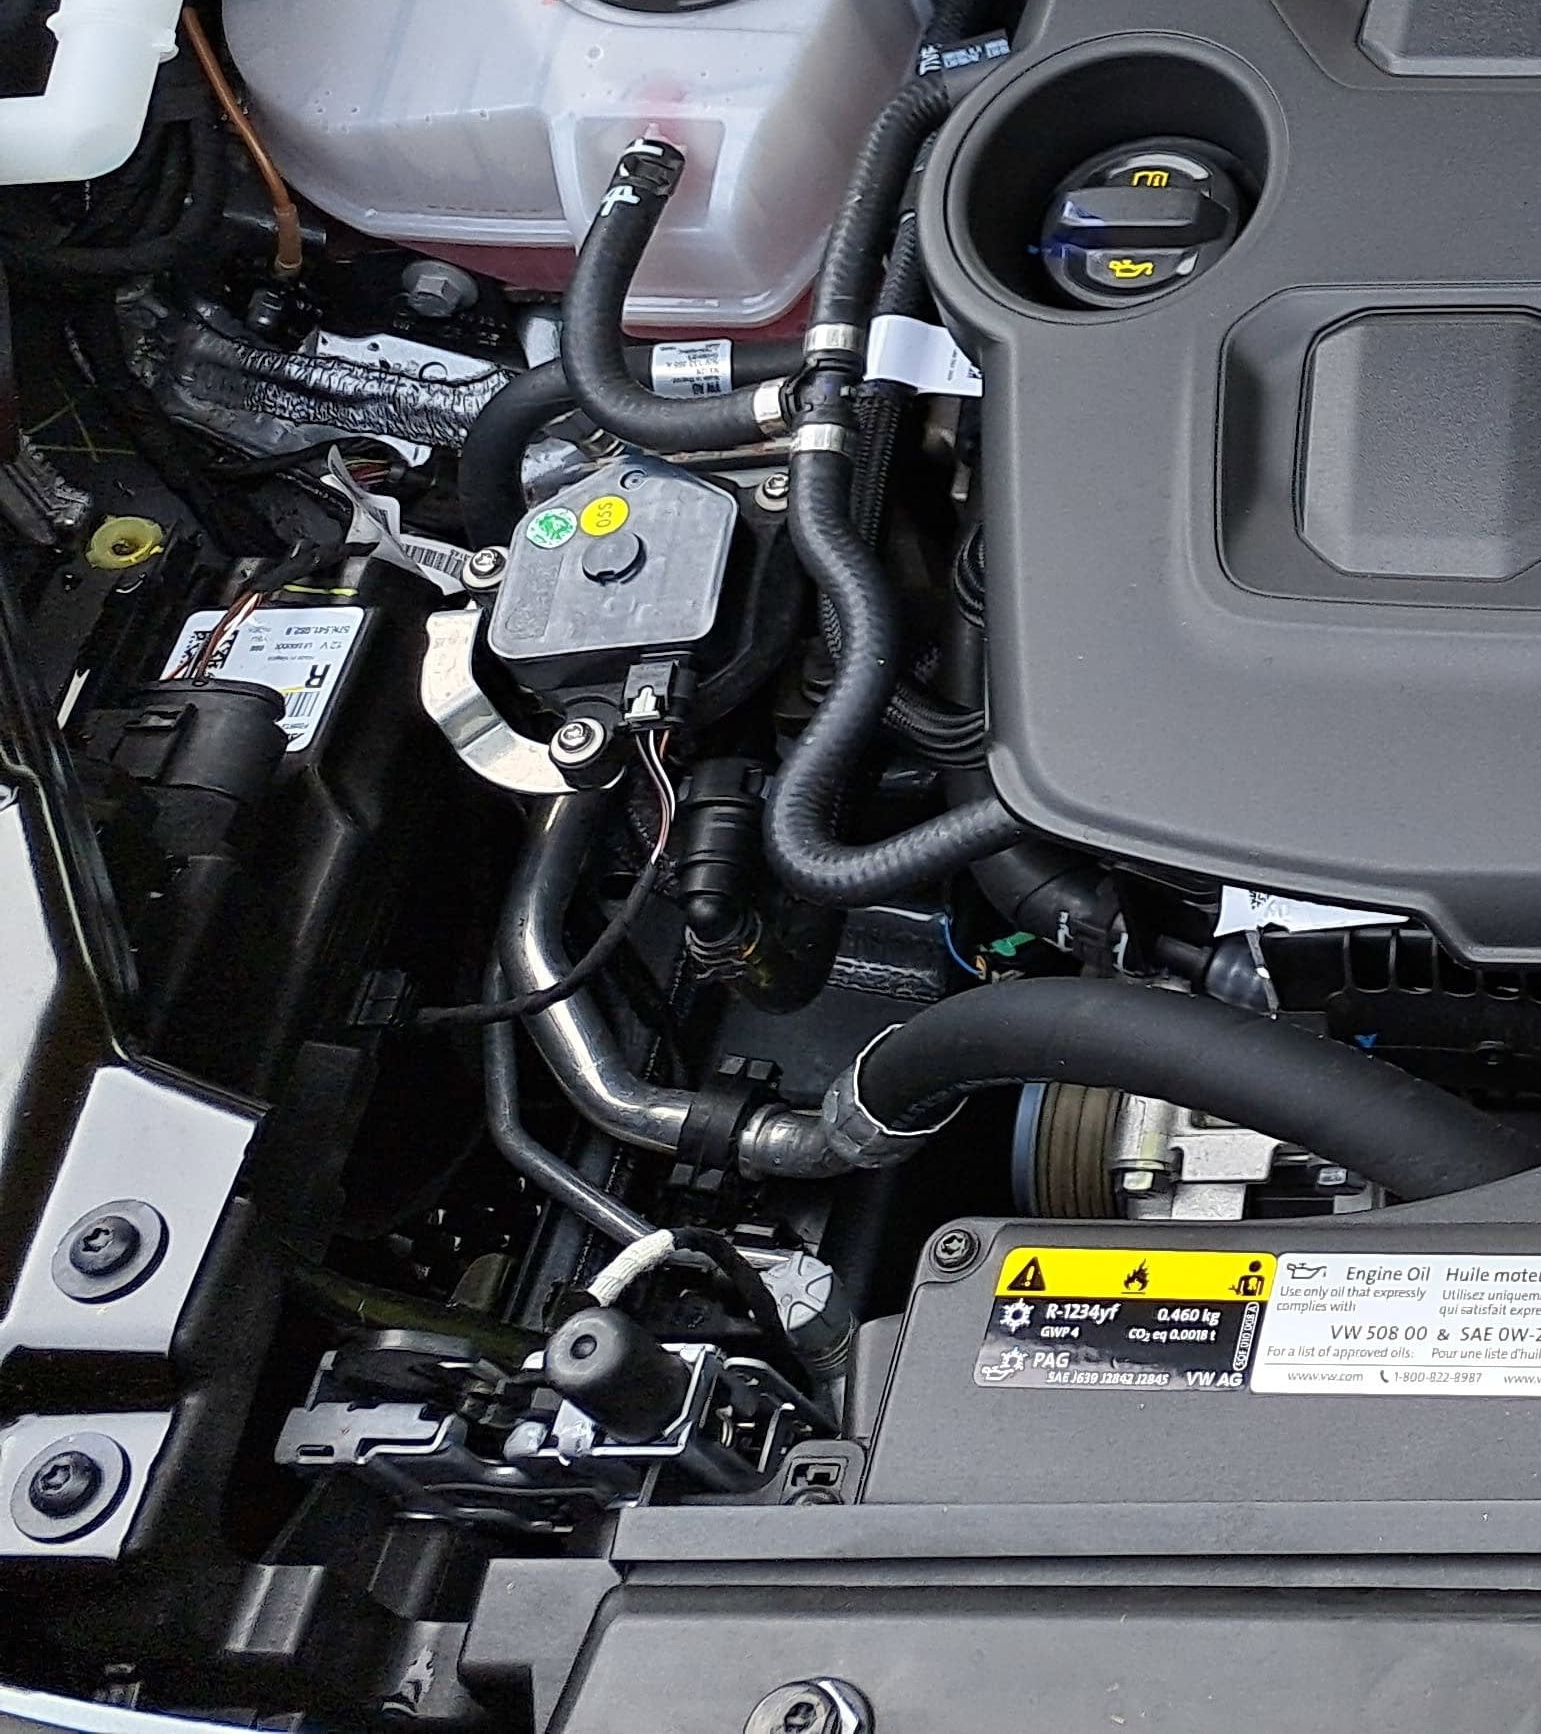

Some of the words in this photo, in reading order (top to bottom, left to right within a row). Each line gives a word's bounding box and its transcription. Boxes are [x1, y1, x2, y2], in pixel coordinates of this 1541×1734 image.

[304, 664, 331, 688] R
[1346, 1266, 1403, 1286] Engine
[1407, 1266, 1431, 1281] Oil
[1446, 1266, 1490, 1282] Huile
[1280, 1286, 1302, 1297] Use
[1303, 1286, 1329, 1300] only
[1330, 1286, 1345, 1297] oil
[1347, 1286, 1371, 1297] that
[1373, 1287, 1427, 1301] expressly
[1442, 1289, 1485, 1301] Utilisez
[1046, 1303, 1122, 1324] R-1234yf
[1156, 1307, 1200, 1322] 0.460
[1201, 1308, 1221, 1326] kg
[1276, 1301, 1327, 1314] complies
[1330, 1301, 1356, 1312] with
[1439, 1305, 1459, 1318] qui
[1460, 1304, 1507, 1316] satisfait
[1040, 1326, 1069, 1339] GWP
[1069, 1326, 1080, 1339] 4
[1152, 1331, 1168, 1343] eq
[1168, 1329, 1208, 1342] 0.0018
[1208, 1330, 1217, 1341] t
[1330, 1325, 1363, 1341] VW
[1366, 1325, 1400, 1341] 508
[1404, 1326, 1428, 1341] 00
[1437, 1328, 1450, 1341] &
[1460, 1326, 1494, 1342] SAE
[1033, 1351, 1070, 1369] PAG
[1267, 1346, 1285, 1358] For
[1287, 1349, 1295, 1357] a
[1298, 1346, 1315, 1357] list
[1318, 1346, 1330, 1357] of
[1333, 1347, 1388, 1360] approved
[1390, 1347, 1415, 1358] oils:
[1431, 1348, 1458, 1359] Pour
[1460, 1350, 1482, 1360] une
[1484, 1348, 1508, 1360] liste
[1186, 1371, 1219, 1386] VW
[1219, 1372, 1244, 1387] AG
[1287, 1372, 1364, 1382] www.vw.com
